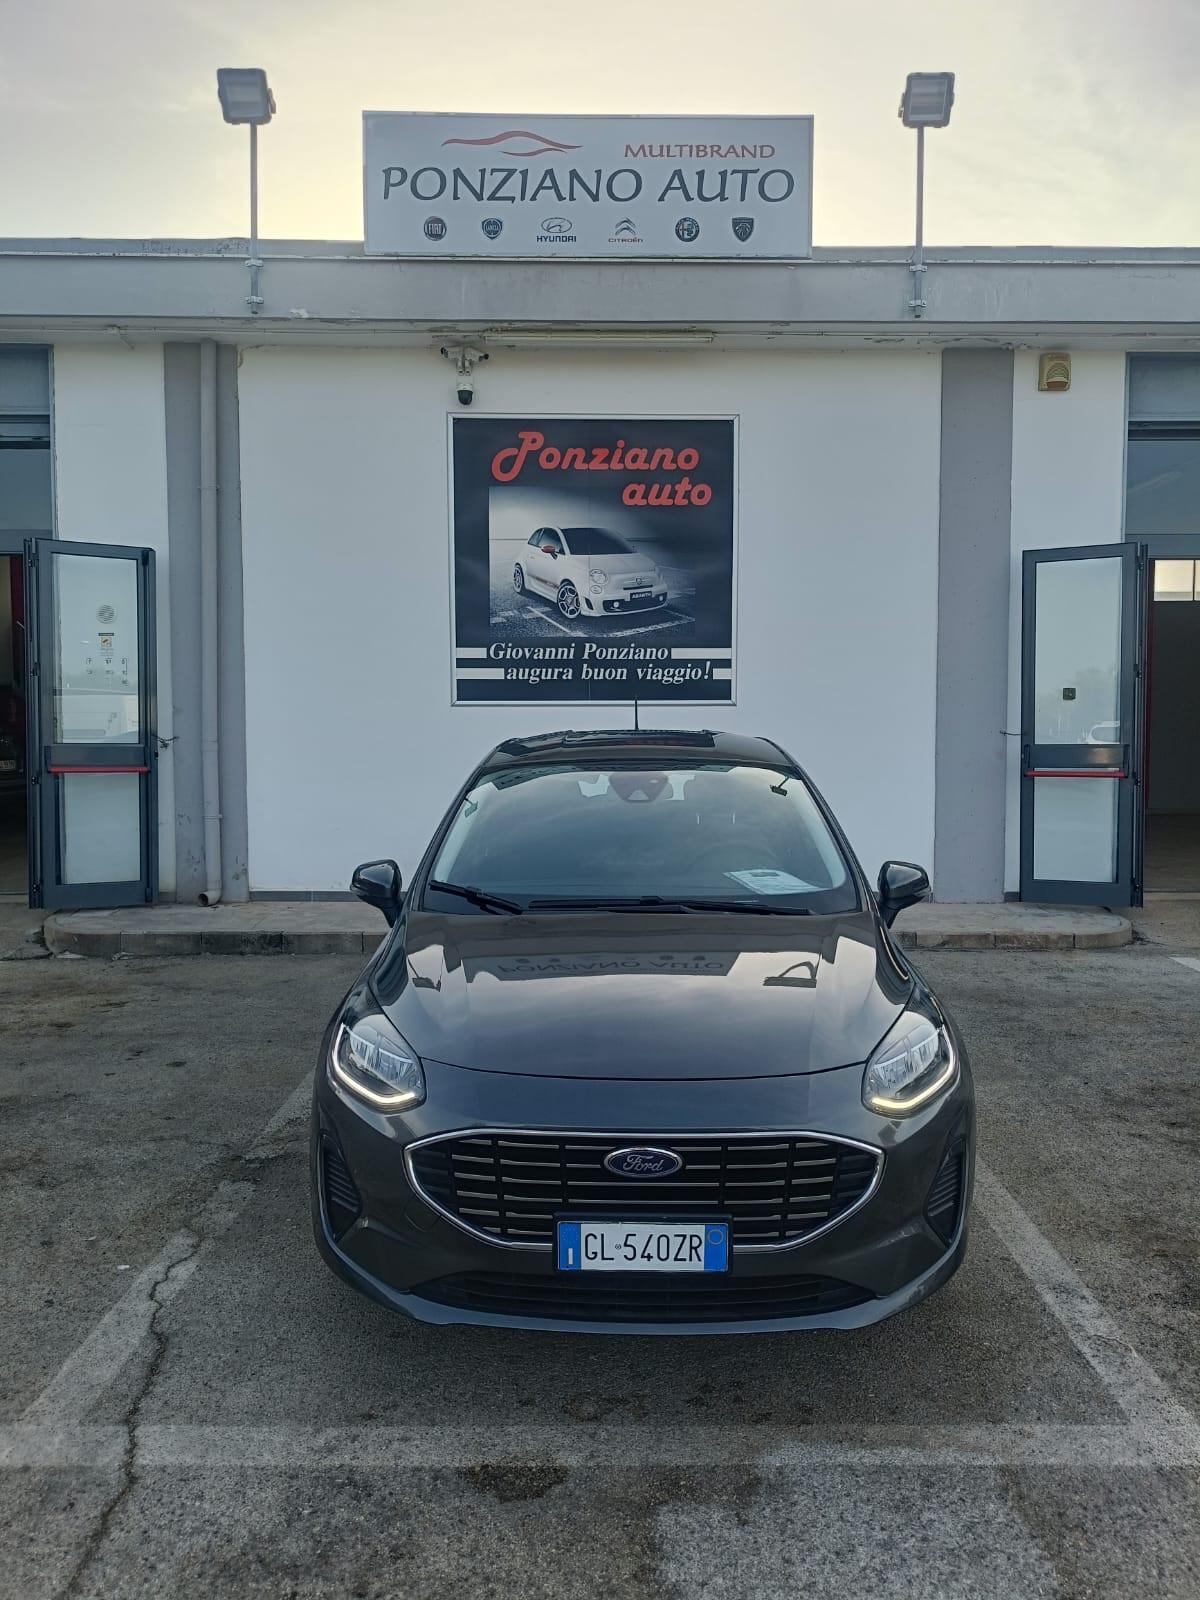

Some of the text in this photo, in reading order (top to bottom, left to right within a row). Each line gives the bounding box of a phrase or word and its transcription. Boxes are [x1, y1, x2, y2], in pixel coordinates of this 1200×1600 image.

[624, 144, 776, 158] MULTIBRAND
[382, 166, 795, 203] PONZIANO AUTO
[428, 223, 442, 235] FIAT
[536, 235, 577, 243] HYUNDAI
[491, 431, 700, 482] Ponziano
[622, 477, 712, 506] auto
[489, 643, 669, 660] Giovanni Ponziano
[506, 661, 711, 684] augura buon viaggio!
[623, 1154, 664, 1172] Ford
